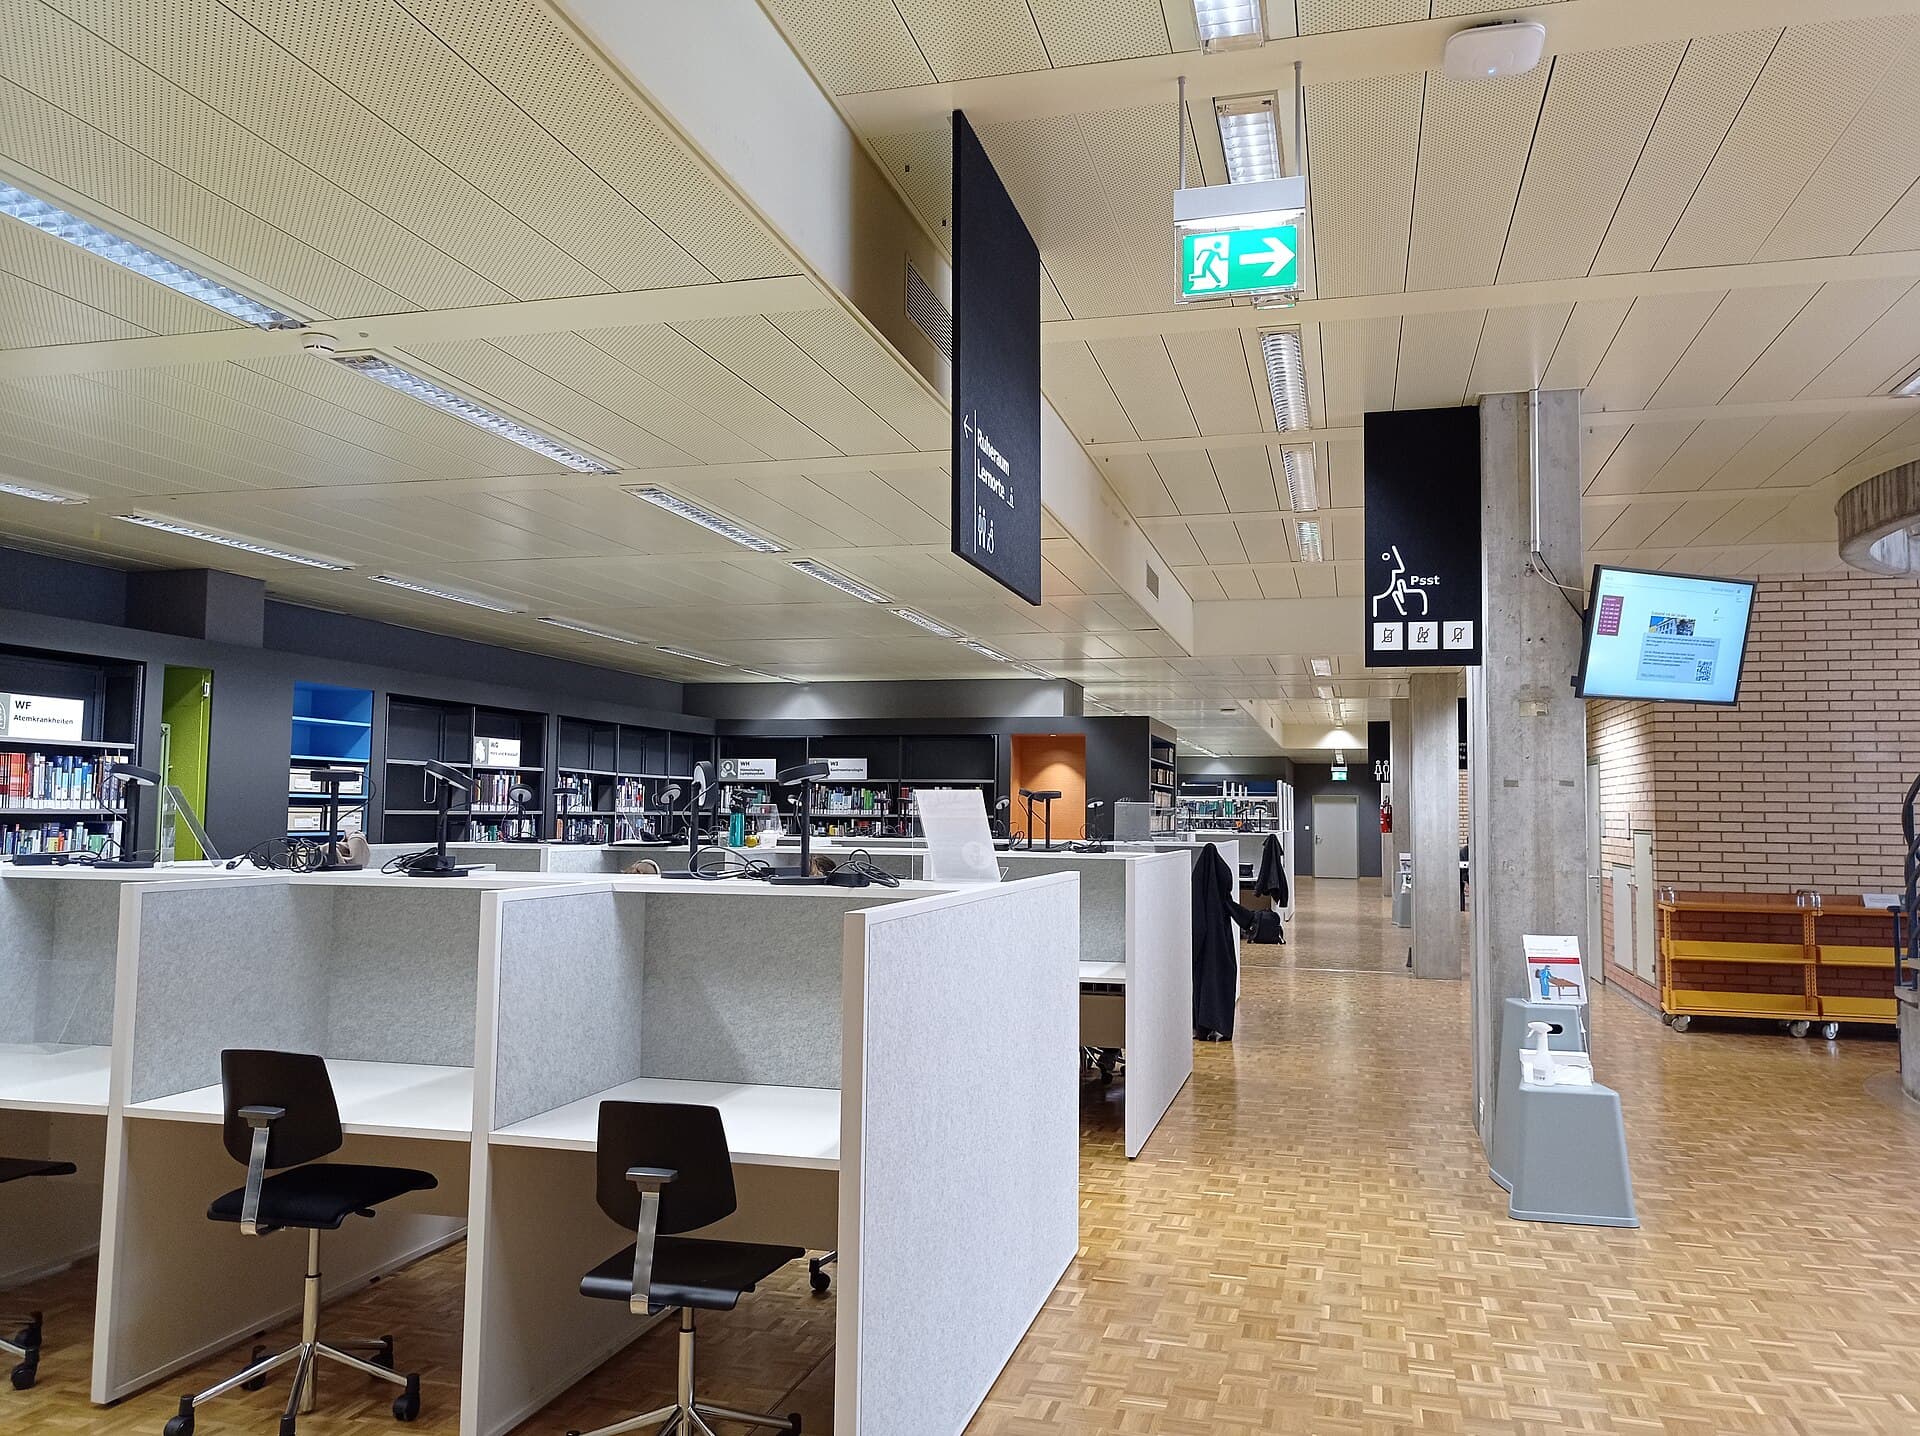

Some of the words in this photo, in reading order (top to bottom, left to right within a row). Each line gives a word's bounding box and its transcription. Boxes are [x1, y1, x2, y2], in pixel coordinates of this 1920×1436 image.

[977, 427, 1010, 477] Ruheraum
[977, 458, 1005, 500] Lernorte
[1410, 575, 1440, 585] Psst
[15, 700, 32, 710] WF
[13, 714, 74, 725] Atemkrankheiten
